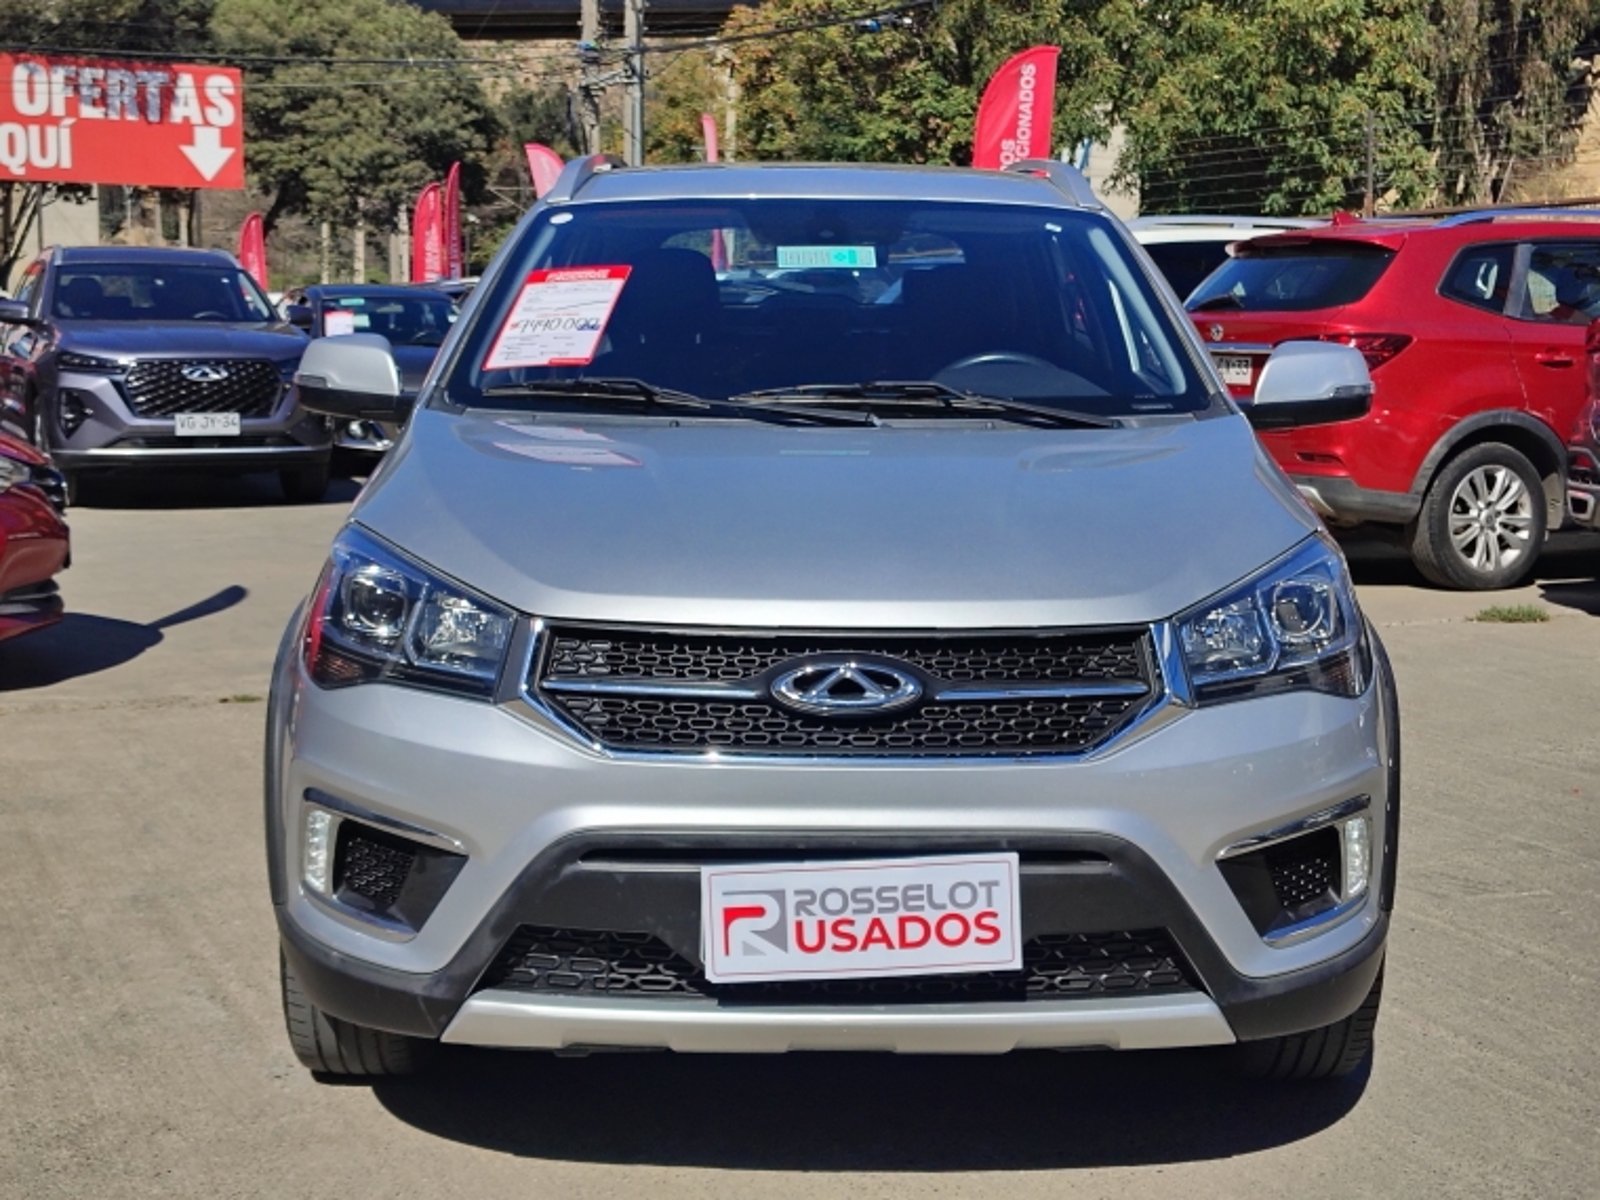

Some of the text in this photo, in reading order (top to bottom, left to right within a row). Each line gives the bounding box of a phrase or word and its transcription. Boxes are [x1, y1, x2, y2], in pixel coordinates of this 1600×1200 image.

[12, 61, 235, 127] OFERTAS
[0, 117, 77, 175] QUÍ
[793, 880, 1000, 916] ROSSELOT
[794, 911, 1001, 954] USADOS
